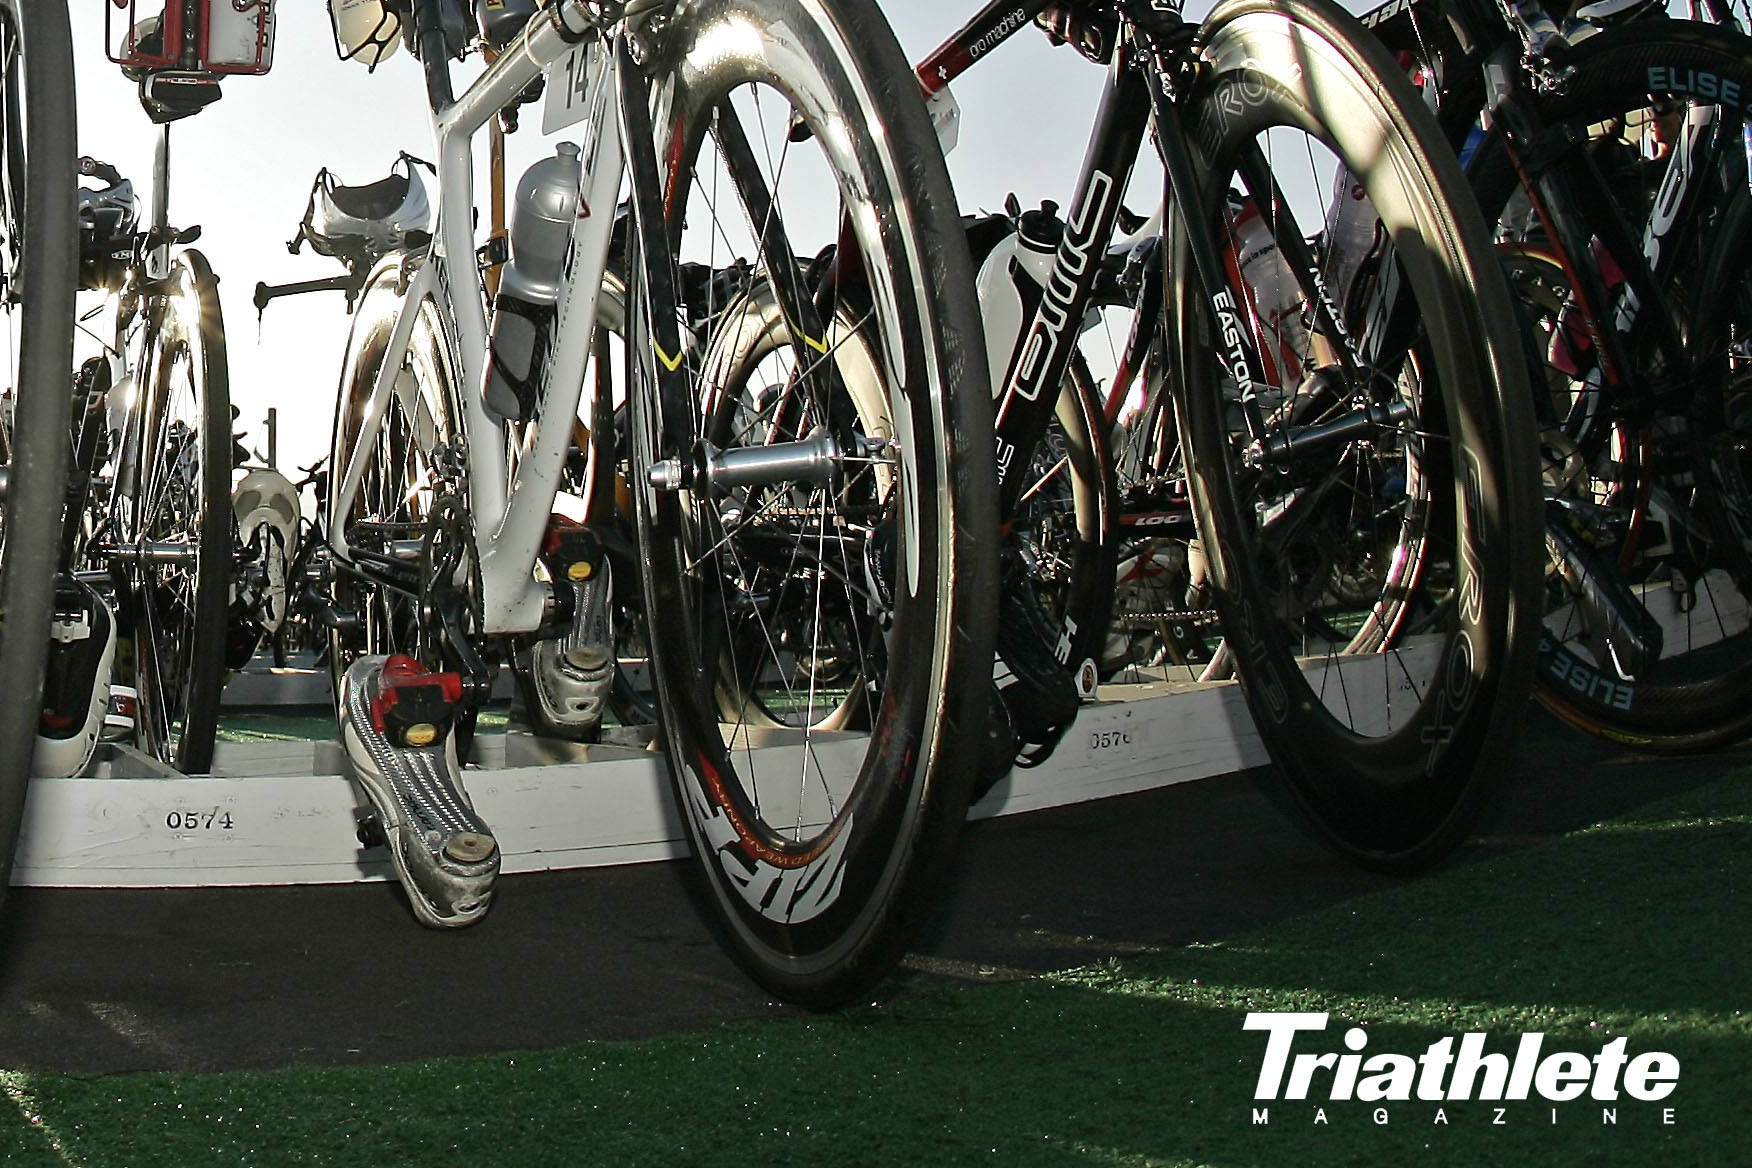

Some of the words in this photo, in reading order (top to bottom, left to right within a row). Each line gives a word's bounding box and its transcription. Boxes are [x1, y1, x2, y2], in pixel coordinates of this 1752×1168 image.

[985, 6, 1027, 45] machine
[565, 42, 589, 110] 14
[1647, 65, 1742, 108] ELISE
[1212, 290, 1256, 404] EASTON
[1549, 649, 1635, 711] ELISE
[165, 806, 235, 831] 0574
